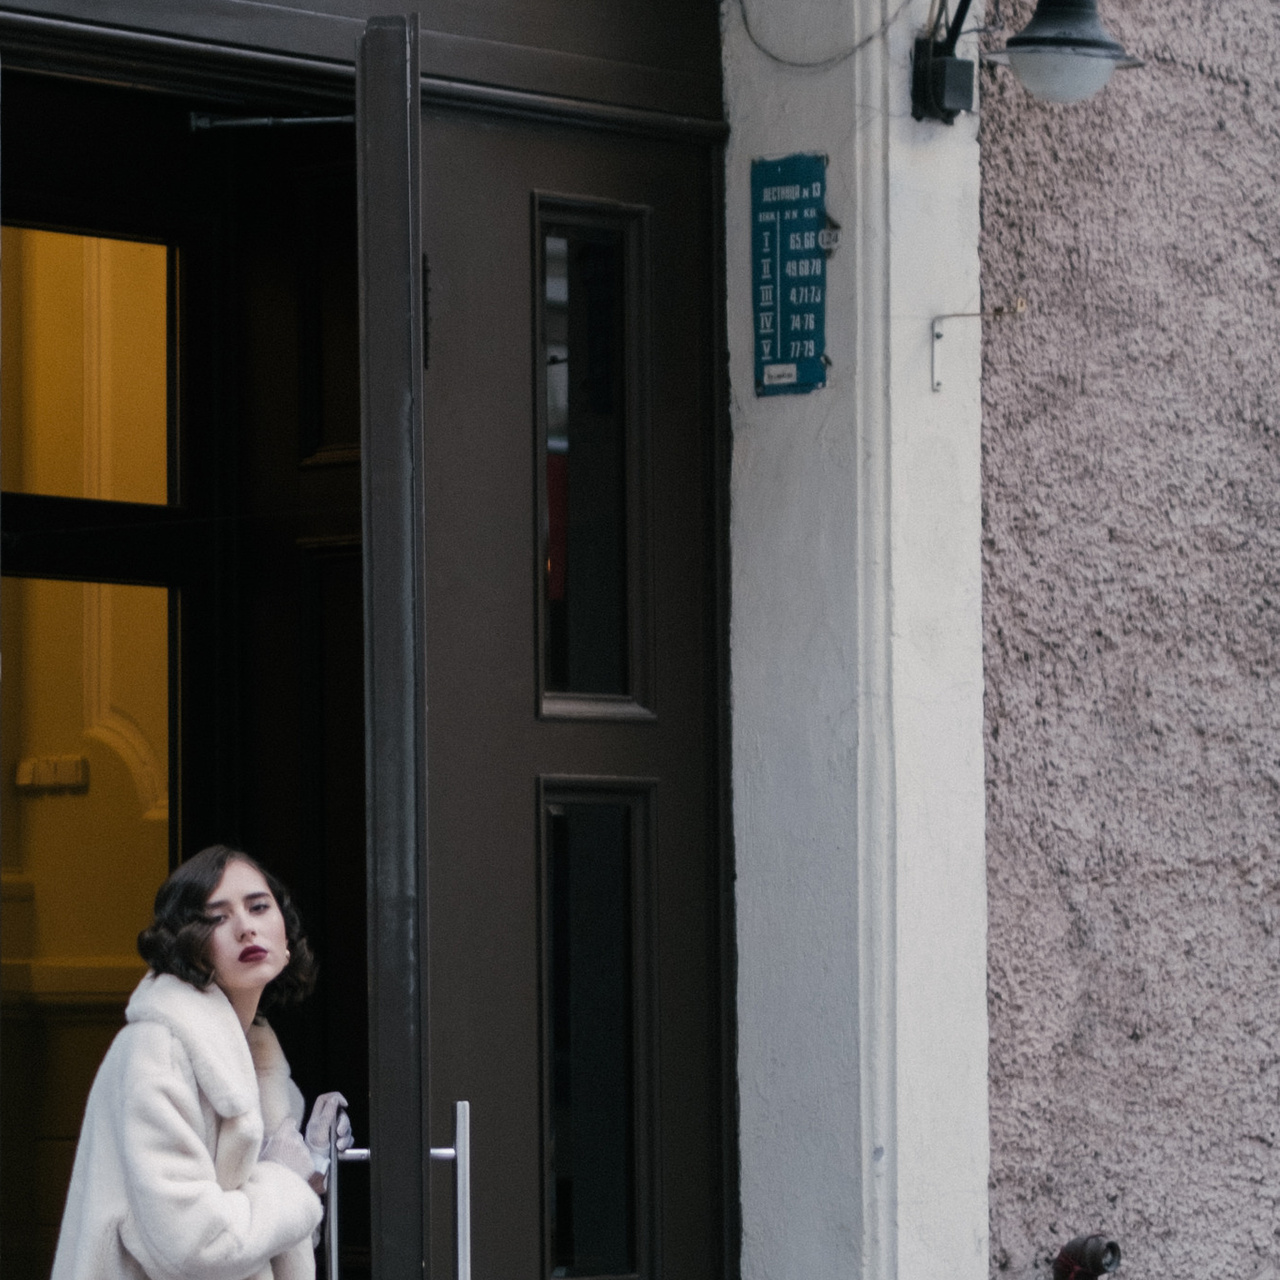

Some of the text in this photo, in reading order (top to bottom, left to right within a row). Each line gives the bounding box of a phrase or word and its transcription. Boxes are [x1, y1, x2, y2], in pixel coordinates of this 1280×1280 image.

[812, 181, 821, 198] 13
[761, 258, 772, 279] II
[760, 285, 774, 307] III
[760, 312, 774, 333] IV
[761, 340, 772, 360] V
